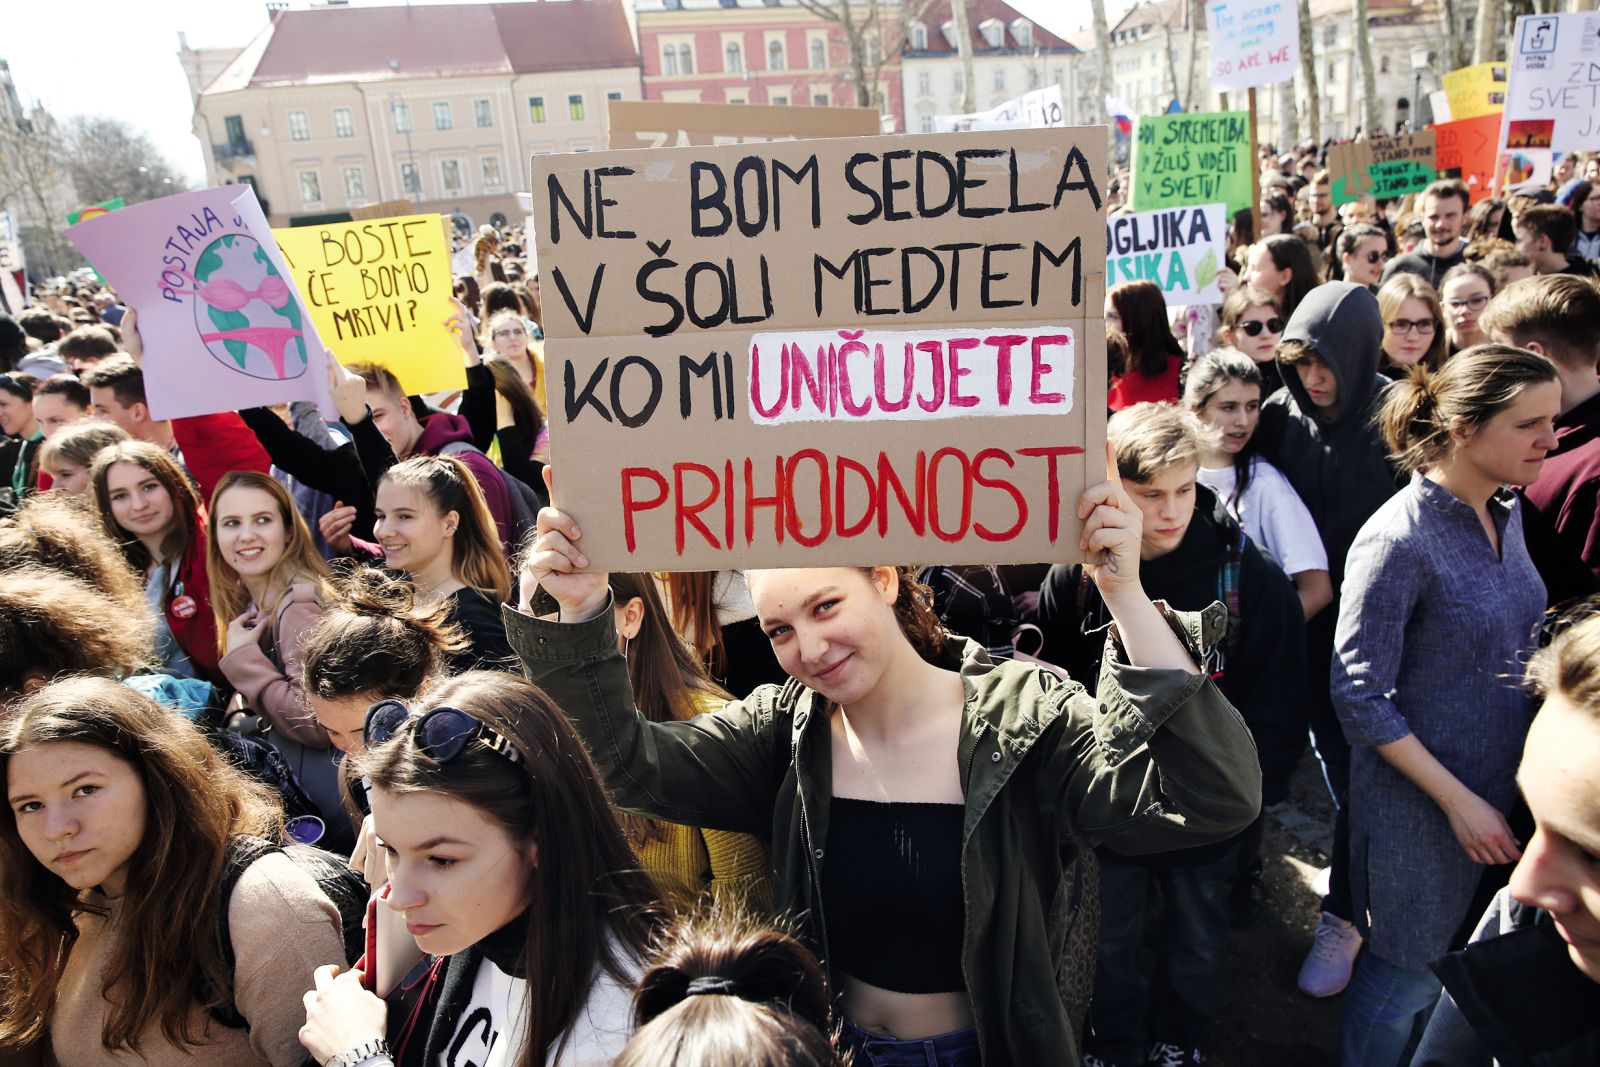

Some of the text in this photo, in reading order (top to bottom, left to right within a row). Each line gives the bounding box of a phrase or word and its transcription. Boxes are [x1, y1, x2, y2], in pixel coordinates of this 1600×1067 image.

[1216, 44, 1291, 76] SO ARE WE
[1197, 146, 1236, 173] VIDETI
[1370, 137, 1413, 151] WHAT I
[1373, 146, 1433, 162] STAND FOR
[1160, 174, 1221, 199] SVETU!
[1374, 175, 1428, 193] STAND ON
[1381, 162, 1410, 176] WHAT
[1416, 162, 1420, 171] I
[549, 145, 1102, 245] NE BOM SEDELA
[161, 206, 225, 304] POSTAJA
[320, 220, 432, 268] BOSTE
[308, 262, 430, 308] ČE BOMO
[551, 236, 1082, 338] V ŠOLI MEDTEM
[332, 299, 418, 341] MRTVI?
[563, 329, 1071, 429] KO MI UNIČUJETE
[620, 445, 1087, 557] PRIHODNOST
